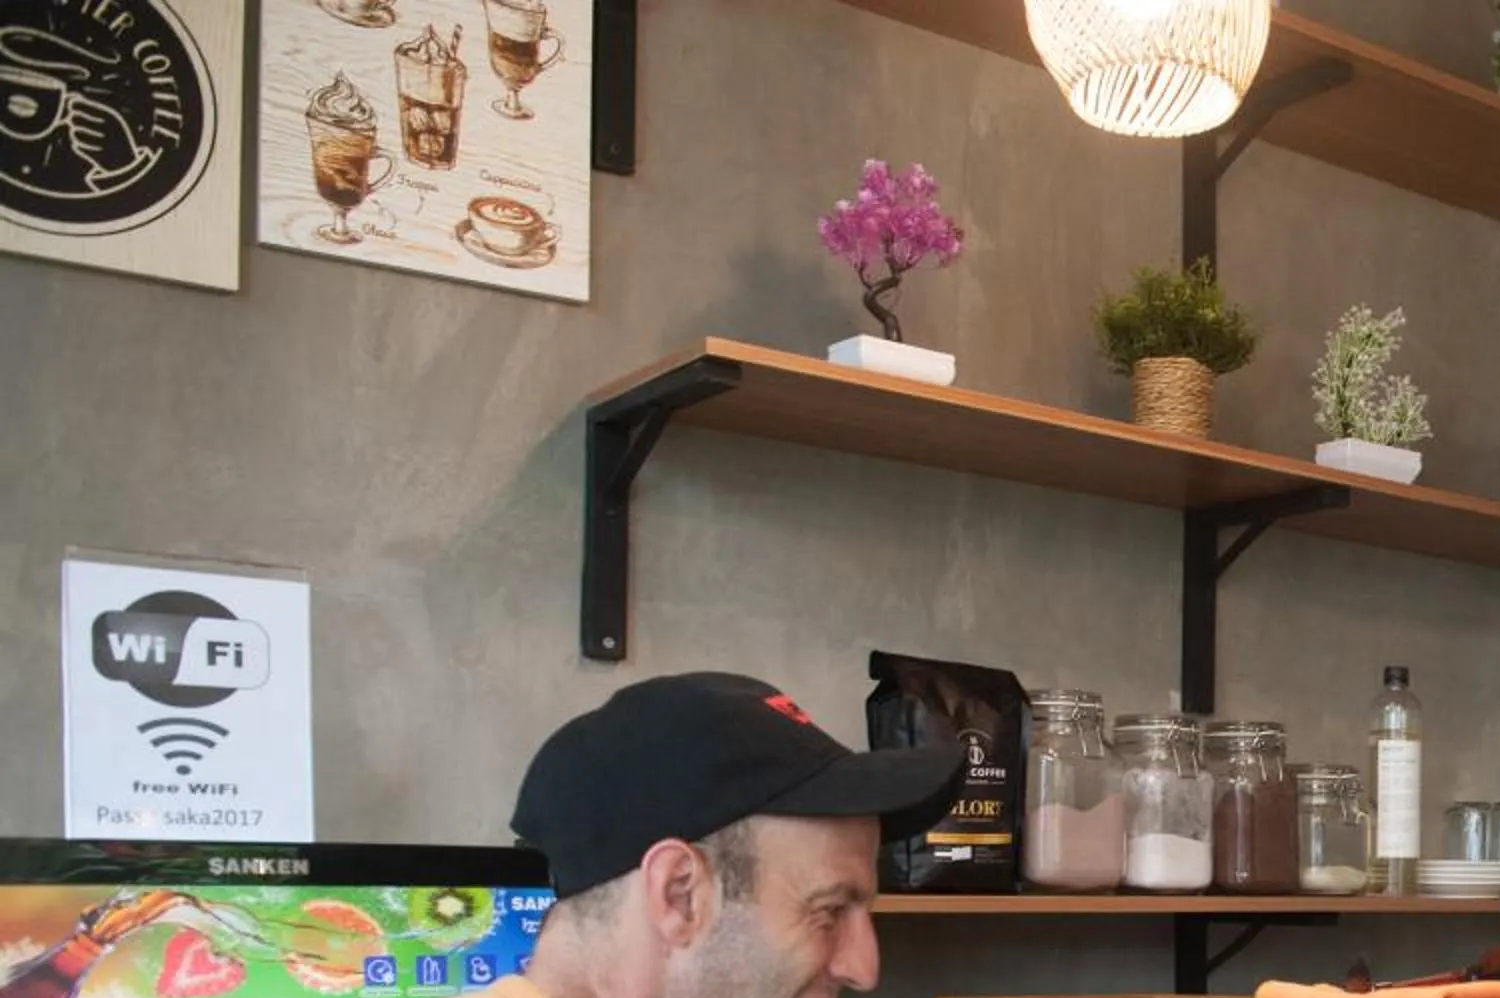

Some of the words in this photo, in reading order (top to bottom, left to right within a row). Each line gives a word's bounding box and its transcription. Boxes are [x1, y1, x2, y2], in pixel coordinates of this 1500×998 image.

[132, 39, 183, 150] COFFEE
[107, 632, 167, 664] Wi
[206, 640, 243, 668] Fi
[132, 780, 181, 794] free
[187, 782, 240, 796] WiFi
[207, 856, 311, 877] SANKEN
[511, 896, 557, 912] SAN
